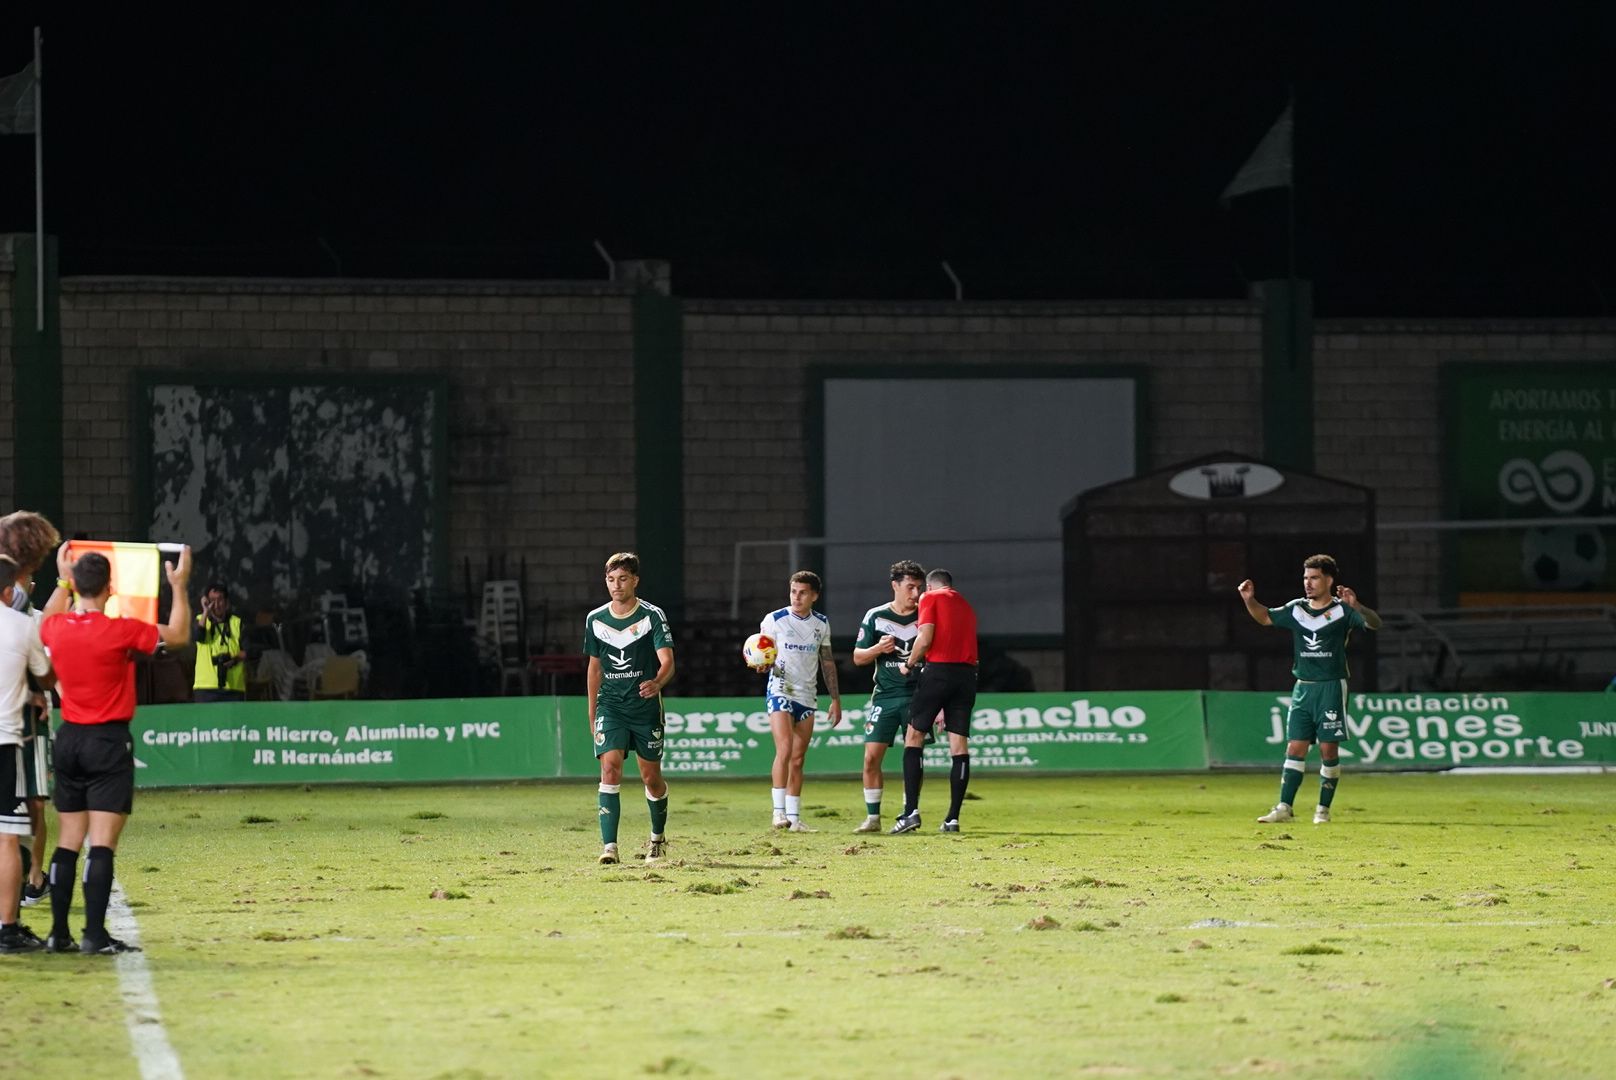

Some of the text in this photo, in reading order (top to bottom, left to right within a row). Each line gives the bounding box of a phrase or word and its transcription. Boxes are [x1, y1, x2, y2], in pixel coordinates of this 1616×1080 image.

[1489, 389, 1602, 409] APORTAMOS
[1500, 416, 1577, 441] ENERGÍA
[1583, 420, 1604, 441] AL
[785, 642, 817, 652] tenerife
[1354, 693, 1509, 712] fundación
[972, 699, 1147, 730] ancho
[142, 722, 501, 747] Carpintería Hierro, Aluminio y PVC
[1265, 706, 1524, 744] jvenes
[664, 738, 744, 749] LOMBIA,
[746, 738, 759, 748] 6
[1002, 730, 1124, 744] HERNÁNDEZ,
[253, 748, 394, 765] JR Hernández
[671, 751, 692, 760] 22
[695, 751, 717, 760] 24
[720, 751, 742, 760] 42
[1358, 735, 1585, 764] ydeporte
